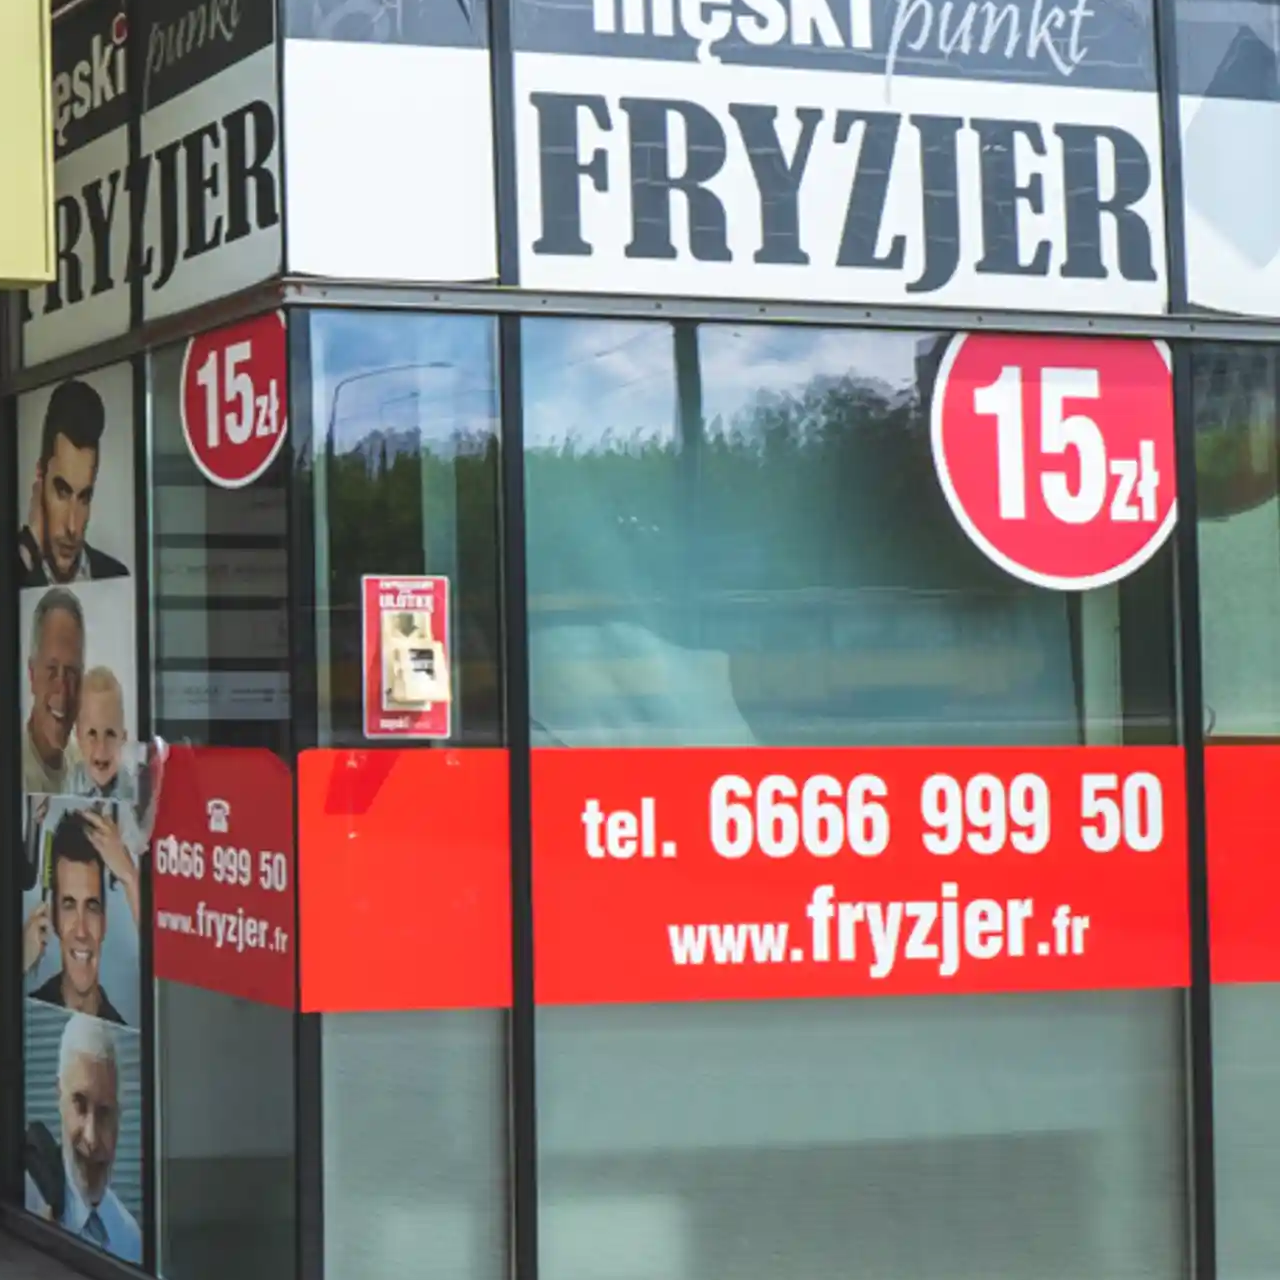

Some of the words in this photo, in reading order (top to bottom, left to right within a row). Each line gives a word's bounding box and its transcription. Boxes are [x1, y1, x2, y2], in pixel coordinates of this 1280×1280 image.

[52, 12, 128, 146] ęski
[25, 99, 280, 319] RYZJER
[529, 91, 1159, 294] FRYZJER
[581, 797, 677, 860] tel.
[708, 774, 891, 859] 6666
[920, 773, 1052, 856] 999
[1080, 771, 1163, 852] 50
[212, 845, 252, 887] 999
[259, 851, 288, 892] 50
[157, 901, 289, 953] www.fryzjer.fr
[668, 882, 1091, 979] www.fryzjer.fr
